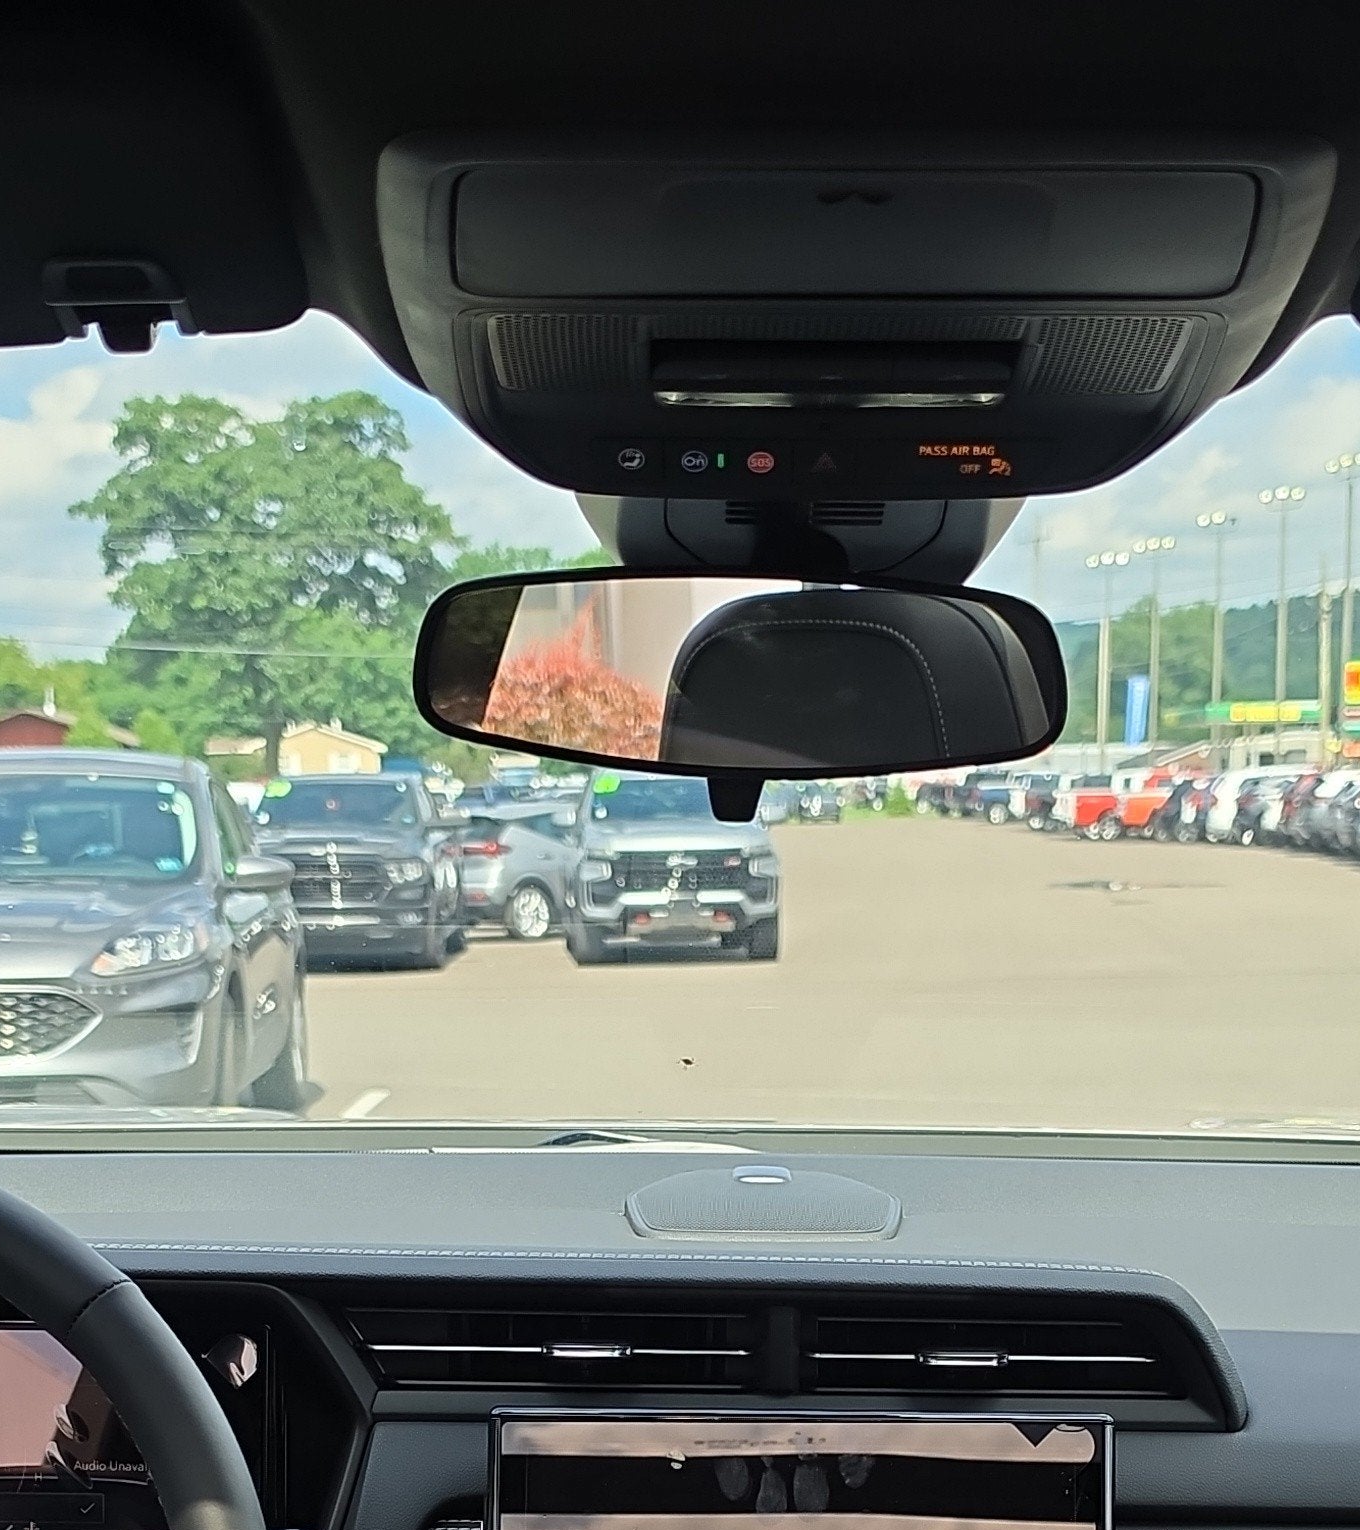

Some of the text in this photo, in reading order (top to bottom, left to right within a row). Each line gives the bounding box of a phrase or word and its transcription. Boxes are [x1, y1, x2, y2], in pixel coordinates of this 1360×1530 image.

[919, 446, 995, 456] PASS AIR BAG
[751, 458, 771, 467] SOS
[960, 464, 981, 474] OFF
[74, 1460, 106, 1472] Audio
